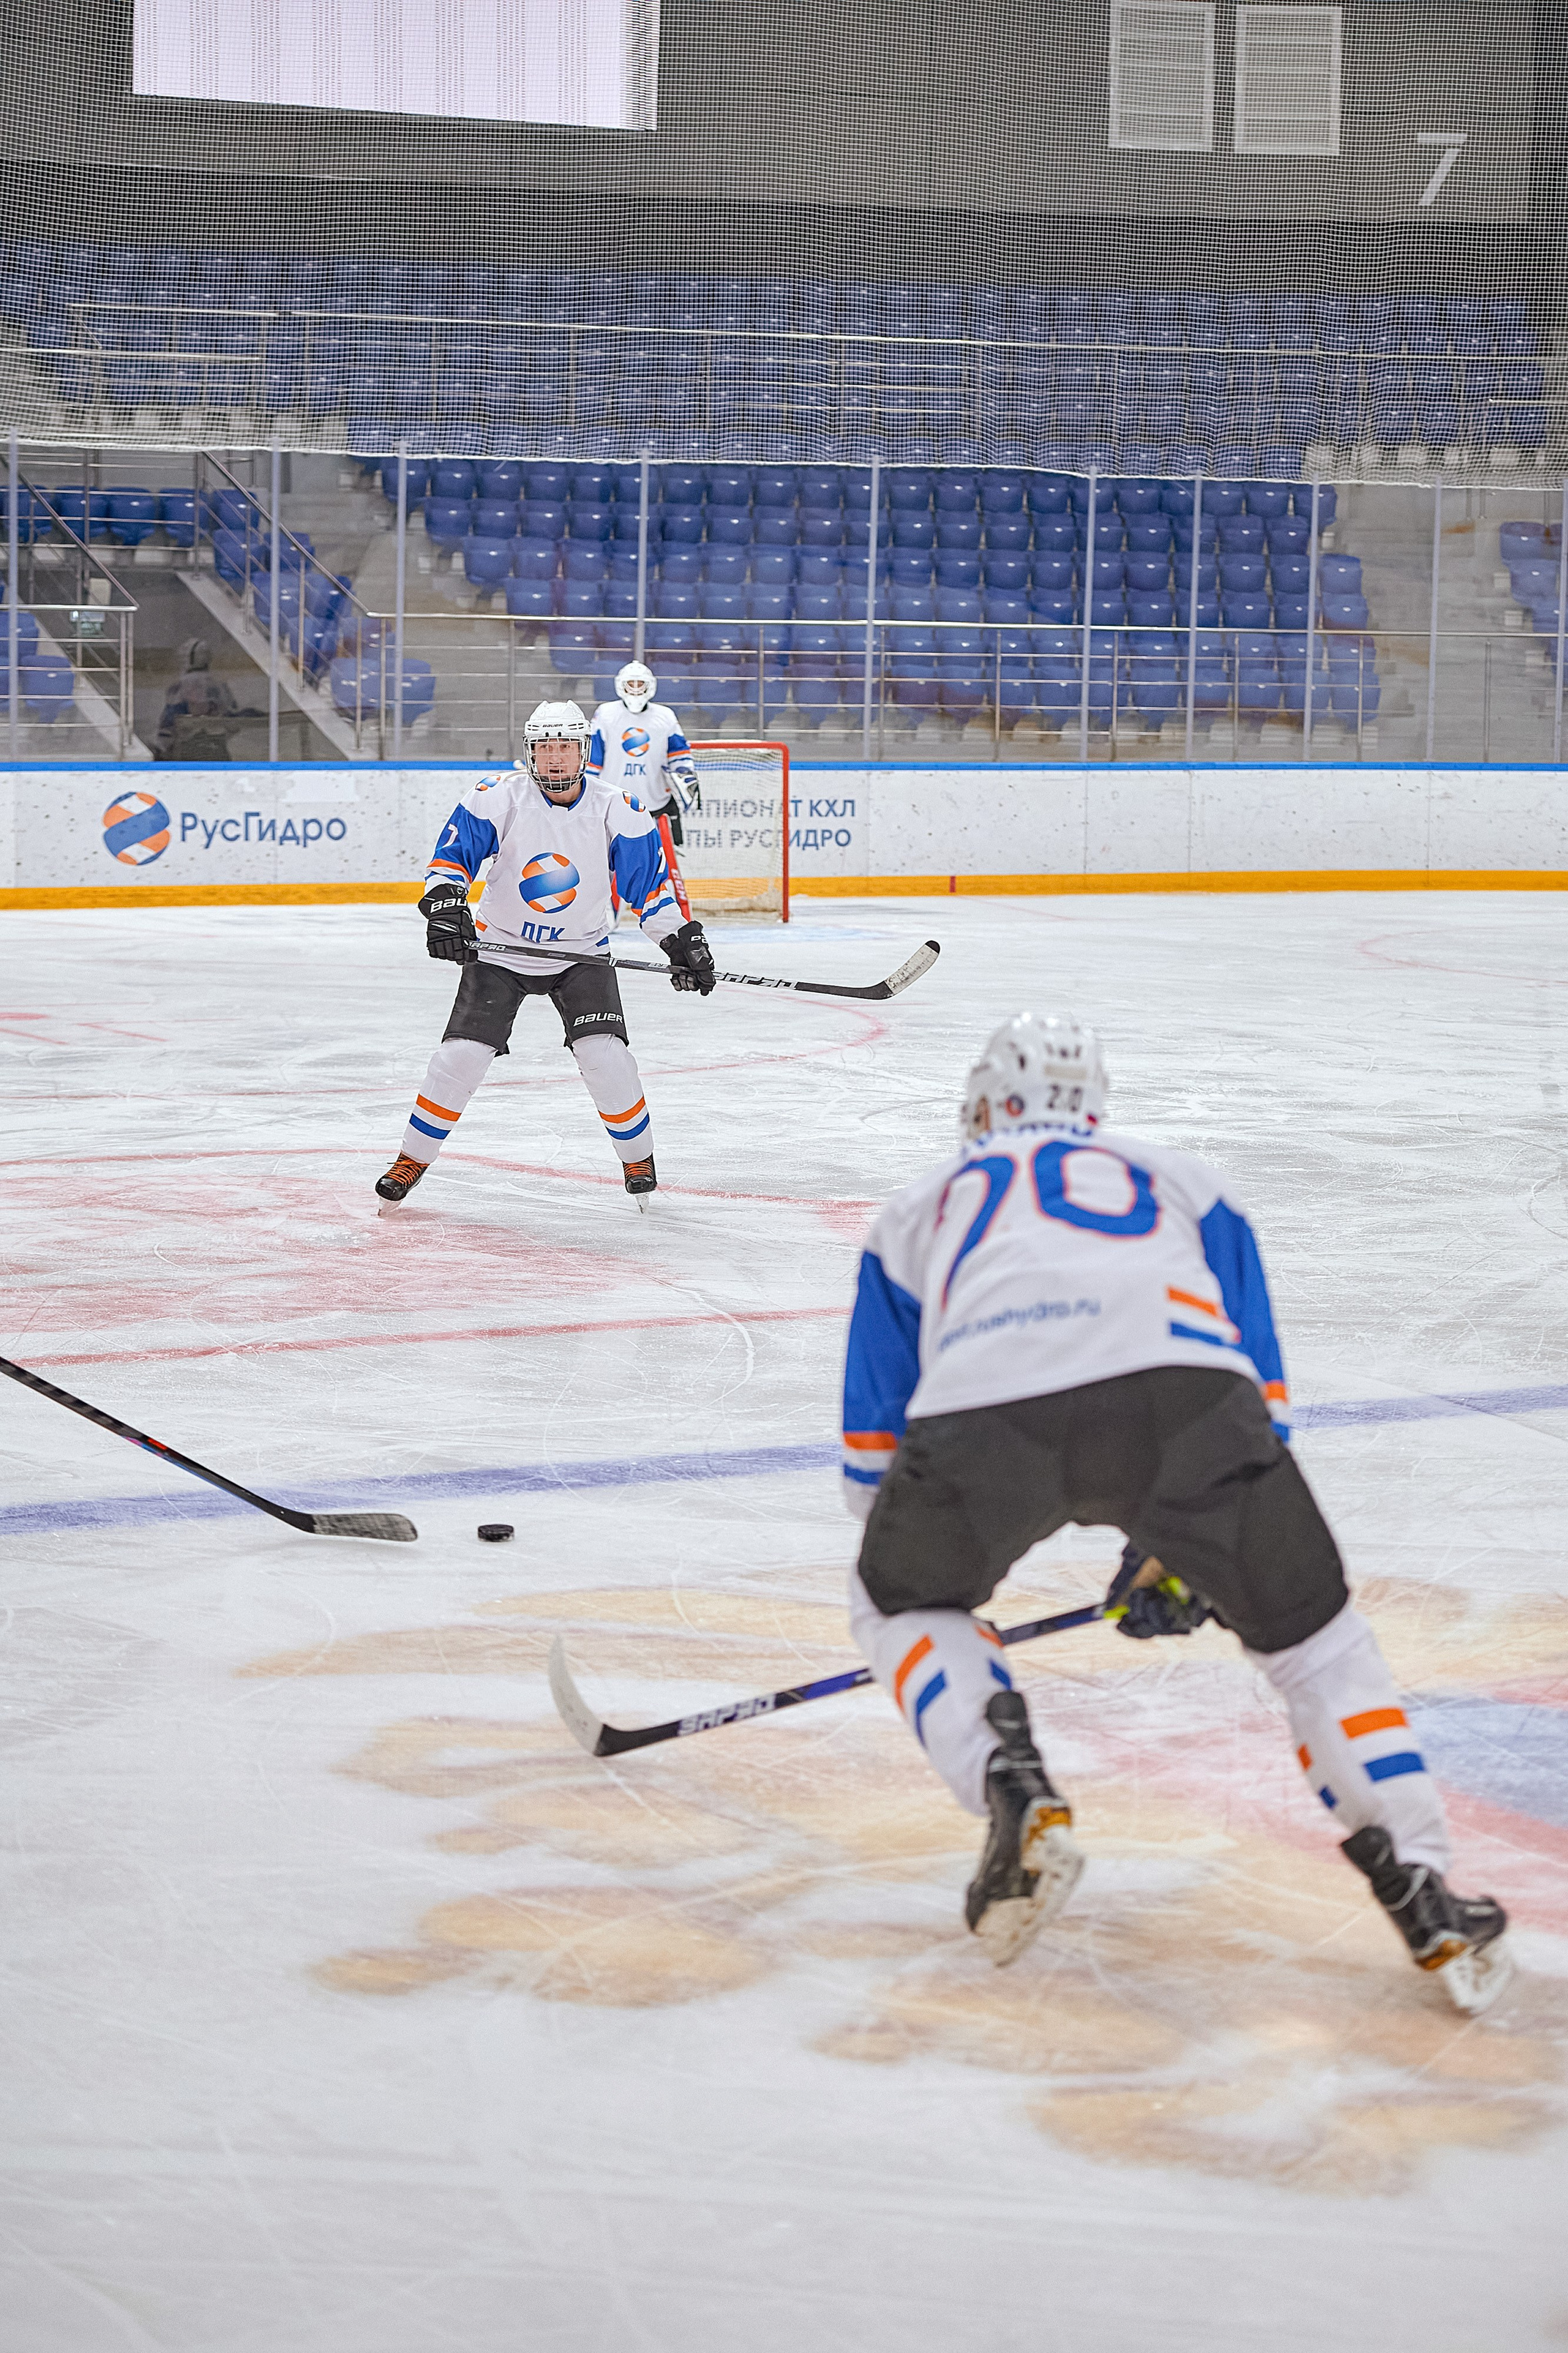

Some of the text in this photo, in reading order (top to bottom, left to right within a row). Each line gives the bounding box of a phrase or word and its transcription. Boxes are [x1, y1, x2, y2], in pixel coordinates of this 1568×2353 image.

[1417, 133, 1467, 205] 7
[624, 763, 647, 777] ДГК
[809, 799, 856, 818] КХЛ
[180, 811, 347, 849] РусГидро
[430, 897, 469, 914] BAU
